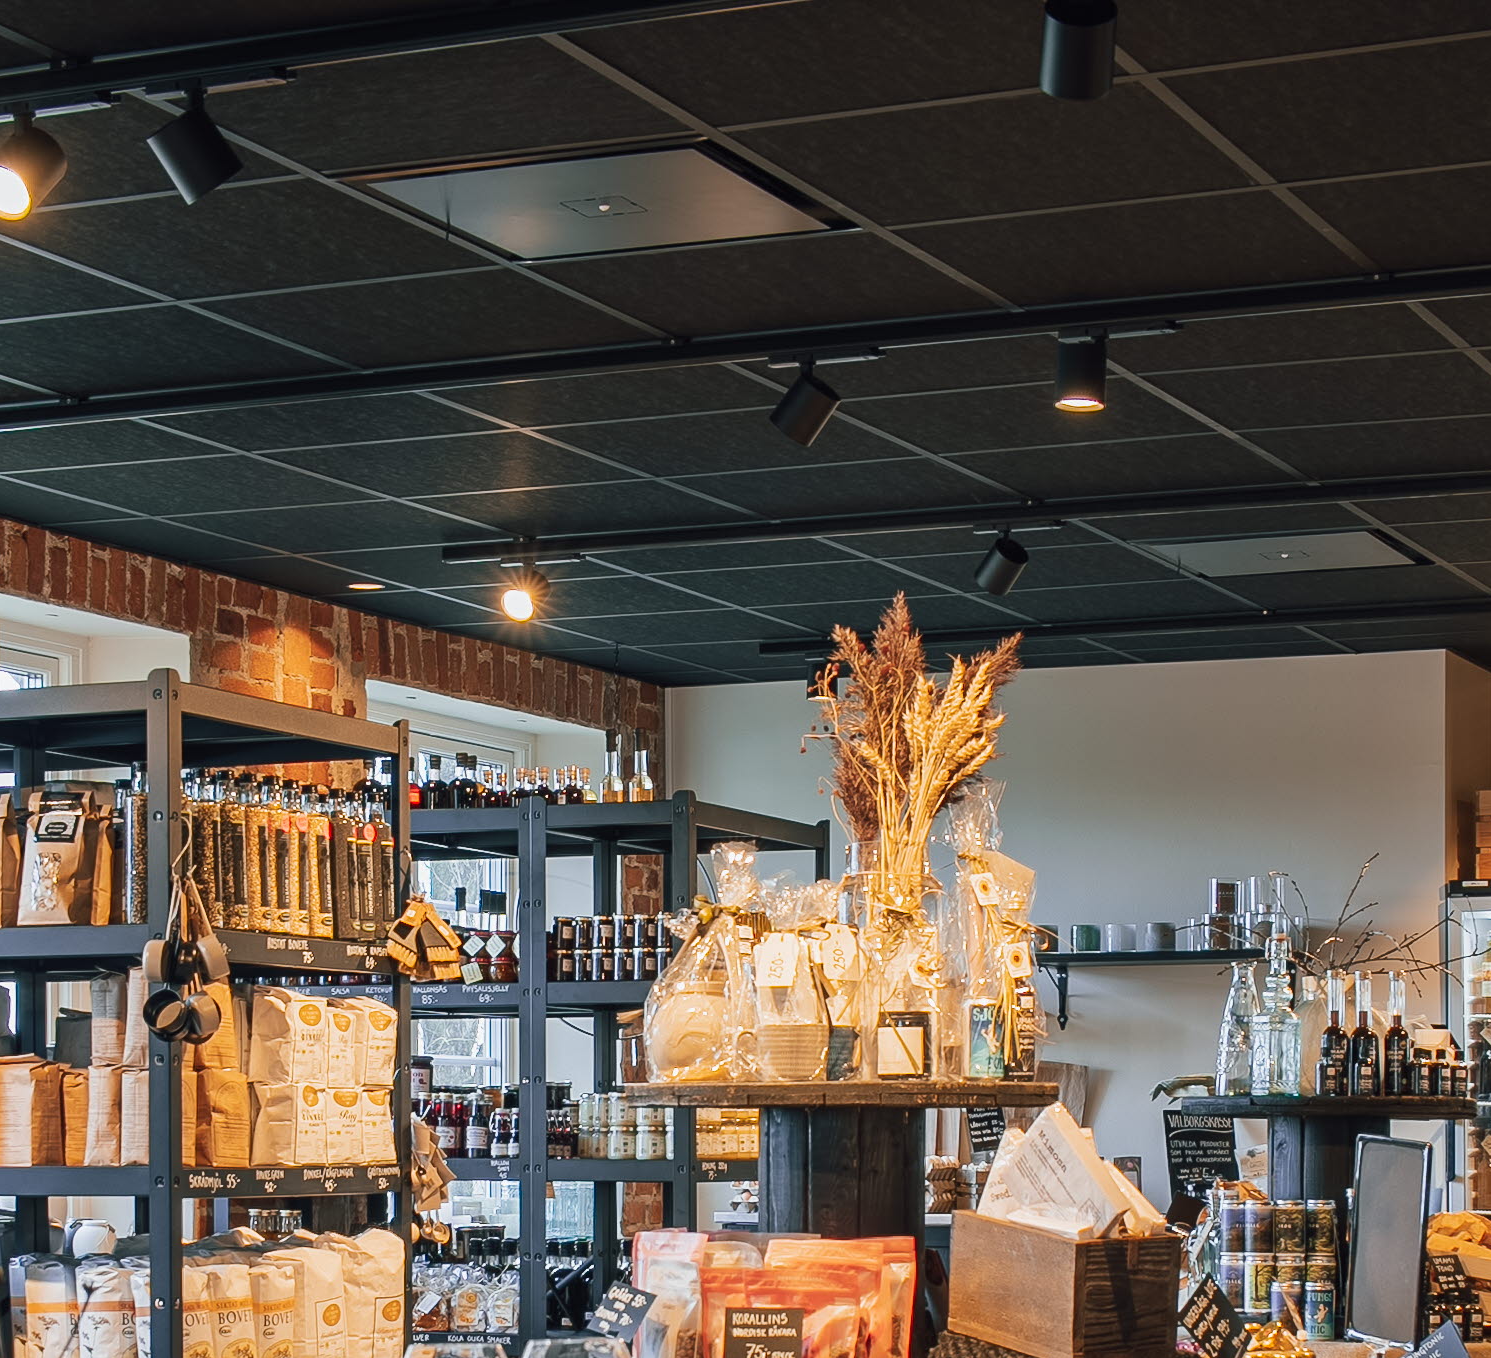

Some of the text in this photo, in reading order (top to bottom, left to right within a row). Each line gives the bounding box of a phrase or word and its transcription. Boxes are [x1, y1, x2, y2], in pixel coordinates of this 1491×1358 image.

[1168, 1115, 1233, 1128] VALBORGSKASSE
[1170, 1140, 1197, 1148] UTVALDA
[218, 1310, 254, 1325] BOVET
[264, 1311, 293, 1327] BOVET
[732, 1313, 788, 1325] KORALLINS
[732, 1327, 767, 1338] NORDISK
[447, 1335, 464, 1343] KOLA
